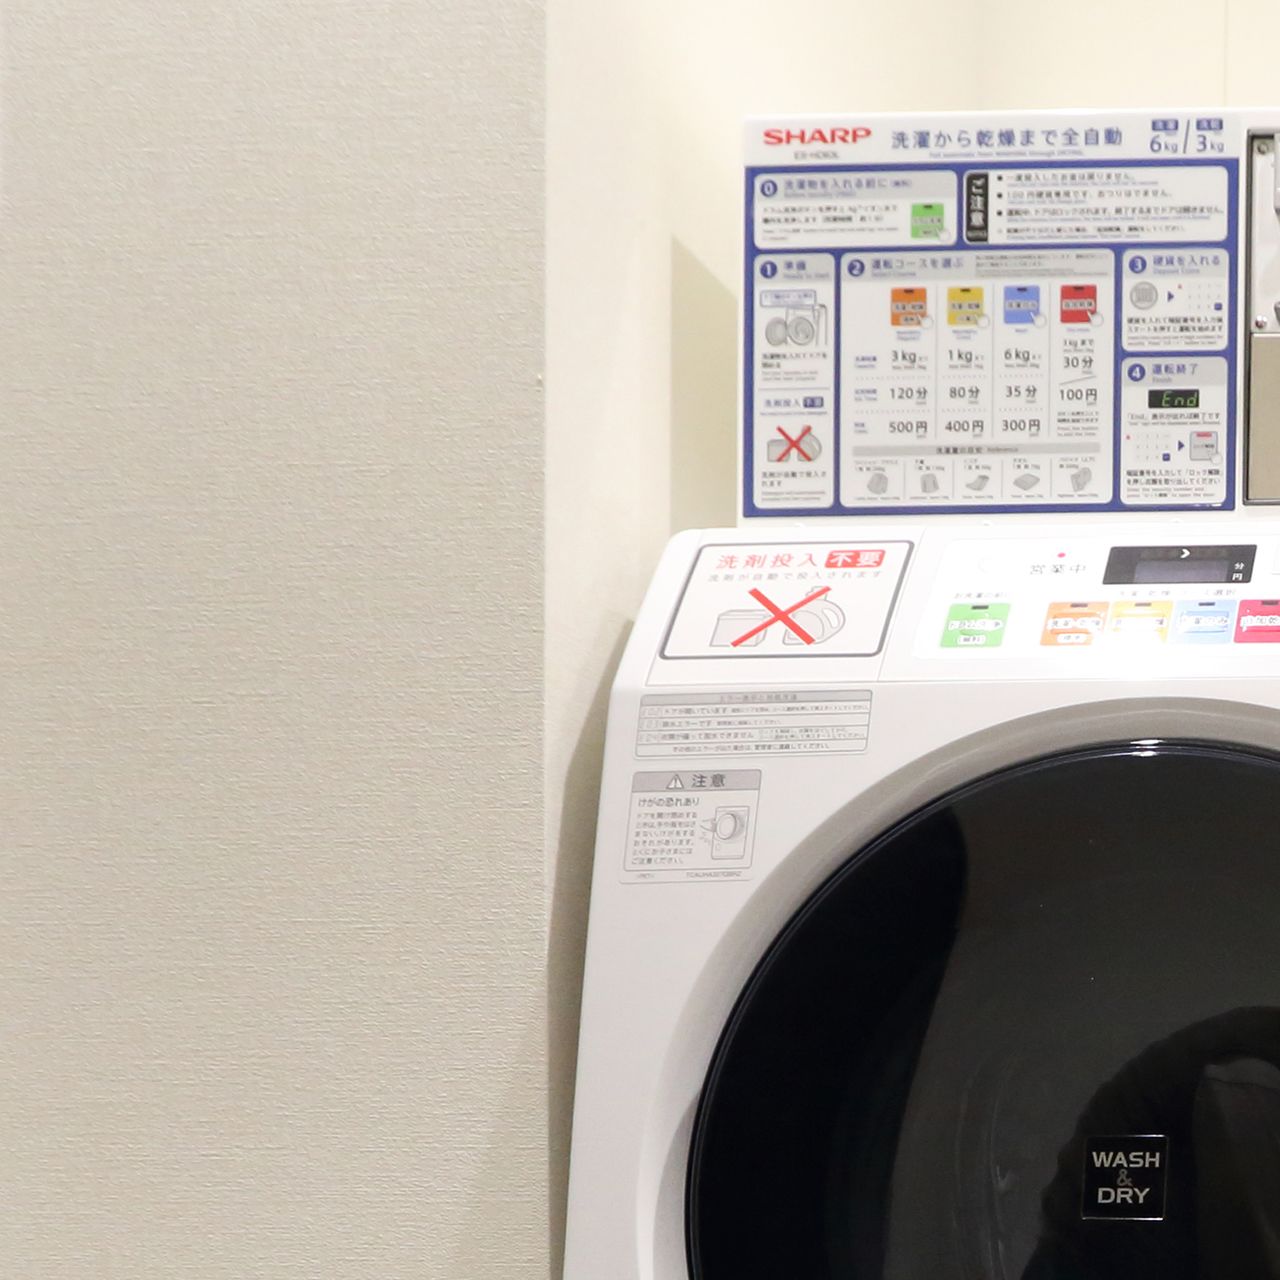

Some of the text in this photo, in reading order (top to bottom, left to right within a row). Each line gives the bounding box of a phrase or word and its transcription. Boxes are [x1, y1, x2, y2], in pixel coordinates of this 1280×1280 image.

[762, 126, 873, 146] SHARP
[891, 127, 1124, 150] 洗濯から乾燥まで全自動
[1161, 390, 1198, 407] End
[716, 550, 881, 570] 洗剤投入 不要
[1233, 562, 1245, 571] 分
[707, 570, 883, 583] 洗剤が自動で投入されます
[1232, 573, 1243, 581] 円
[691, 773, 727, 788] 注意
[637, 798, 701, 808] けがの恐れあり
[1091, 1151, 1161, 1168] WASH
[1116, 1168, 1133, 1187] &
[1096, 1187, 1151, 1204] DRY
